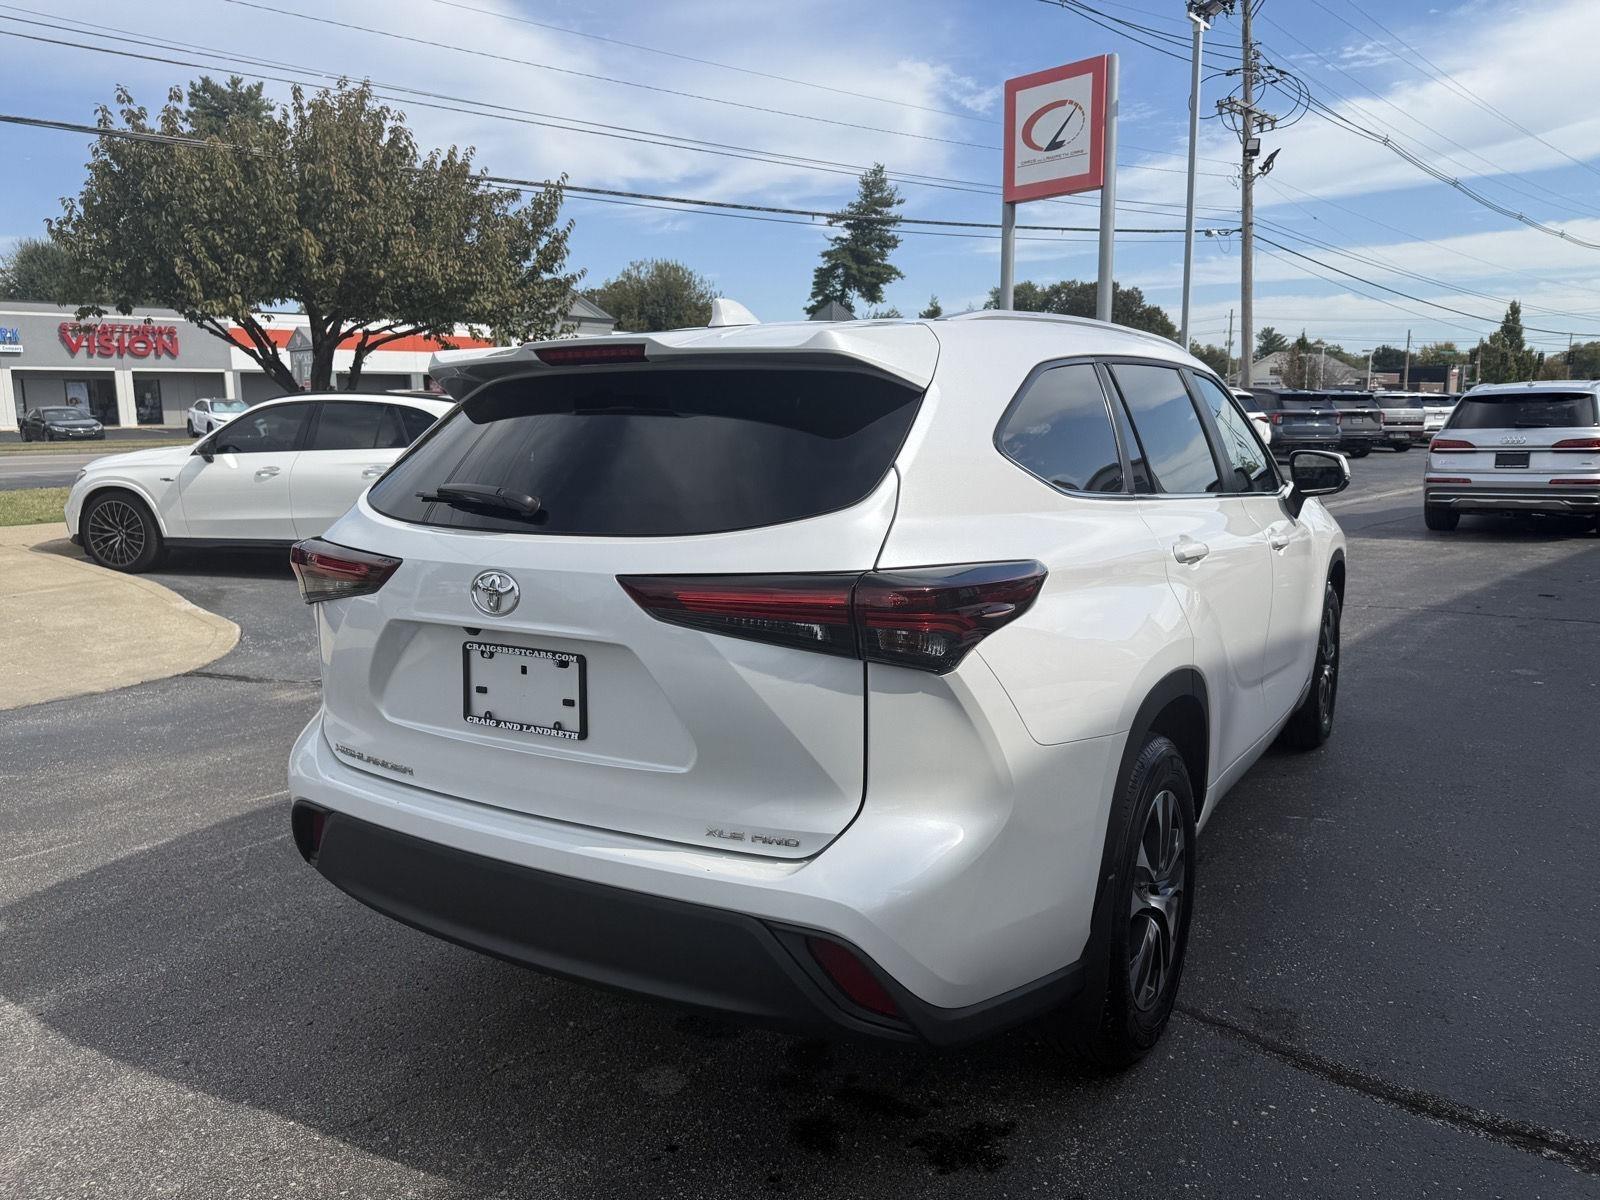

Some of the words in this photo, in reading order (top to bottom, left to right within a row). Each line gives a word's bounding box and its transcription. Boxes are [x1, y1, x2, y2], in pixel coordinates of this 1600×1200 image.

[62, 332, 179, 357] VISION
[466, 643, 578, 664] CRAIGSBESTCARS.COM
[466, 715, 497, 727] CRAIG
[498, 721, 521, 731] AND
[522, 724, 580, 740] LANDRETH
[335, 743, 415, 776] HIGHLANDER
